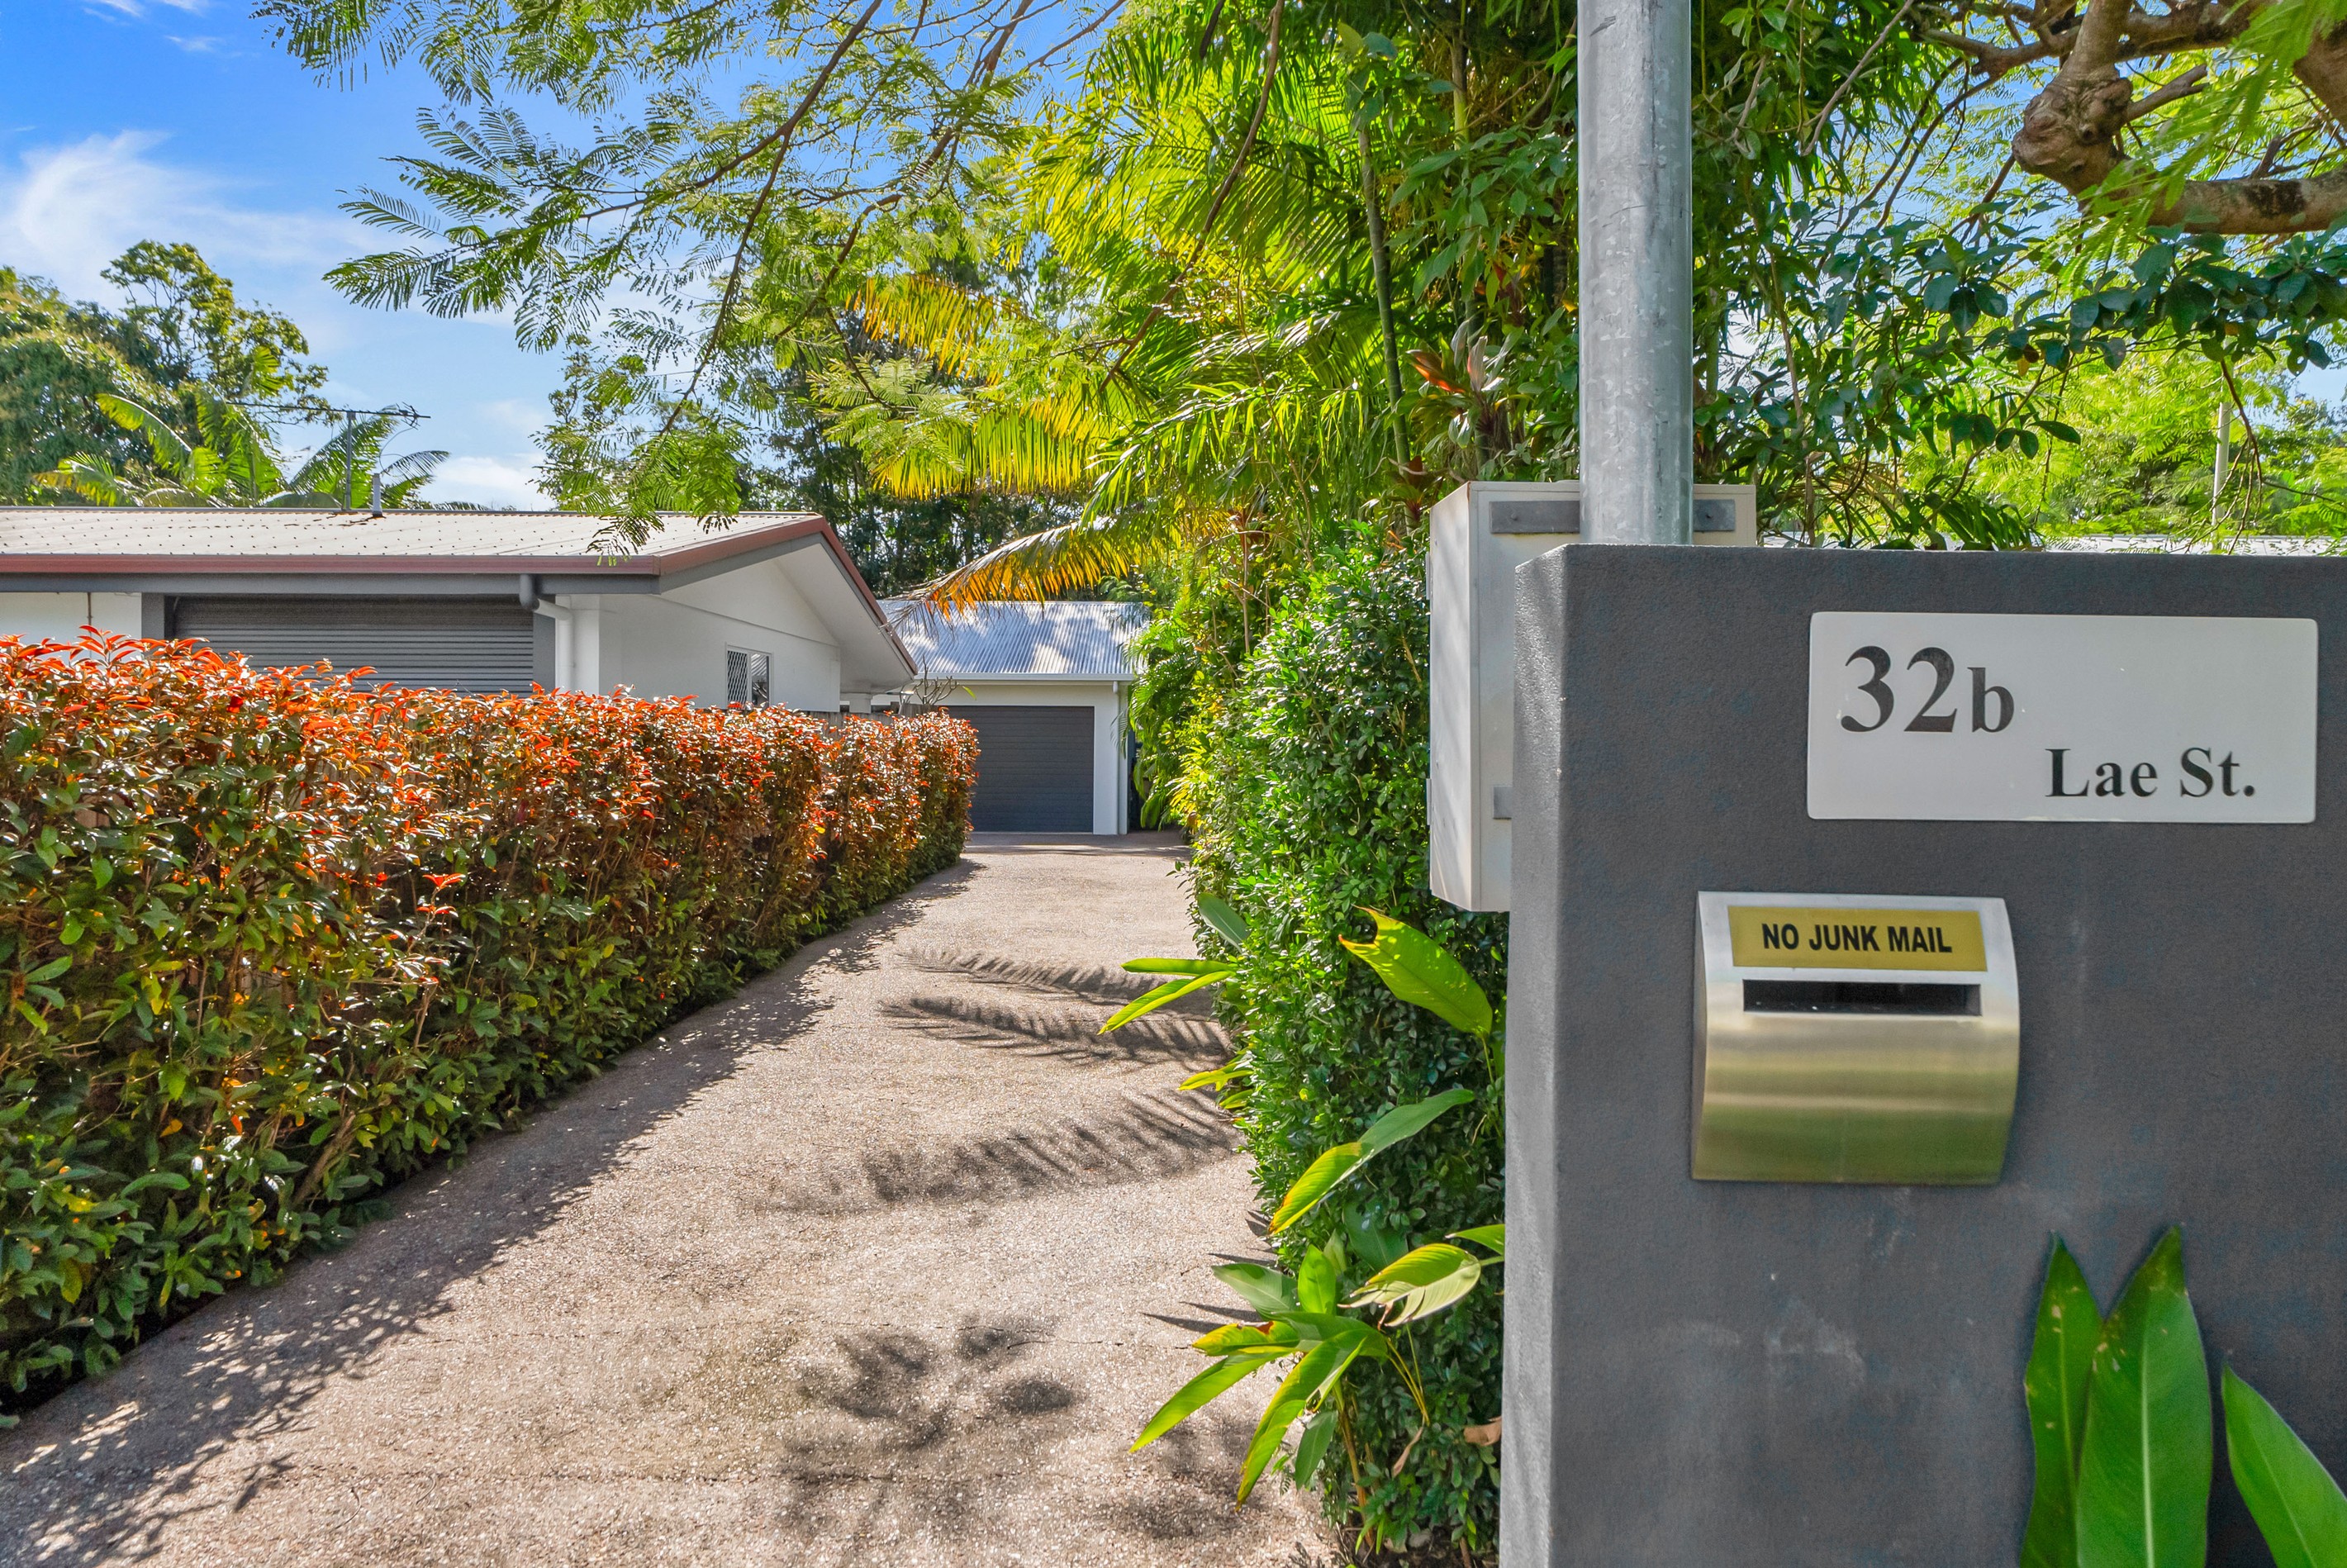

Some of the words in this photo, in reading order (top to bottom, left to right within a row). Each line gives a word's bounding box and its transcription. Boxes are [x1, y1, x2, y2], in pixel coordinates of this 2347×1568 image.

[1841, 645, 2016, 734] 32b
[2045, 748, 2159, 798] Lae
[2178, 747, 2256, 798] St.
[1761, 922, 1800, 951] NO
[1808, 924, 1882, 953] JUNK
[1887, 925, 1954, 954] MAIL
